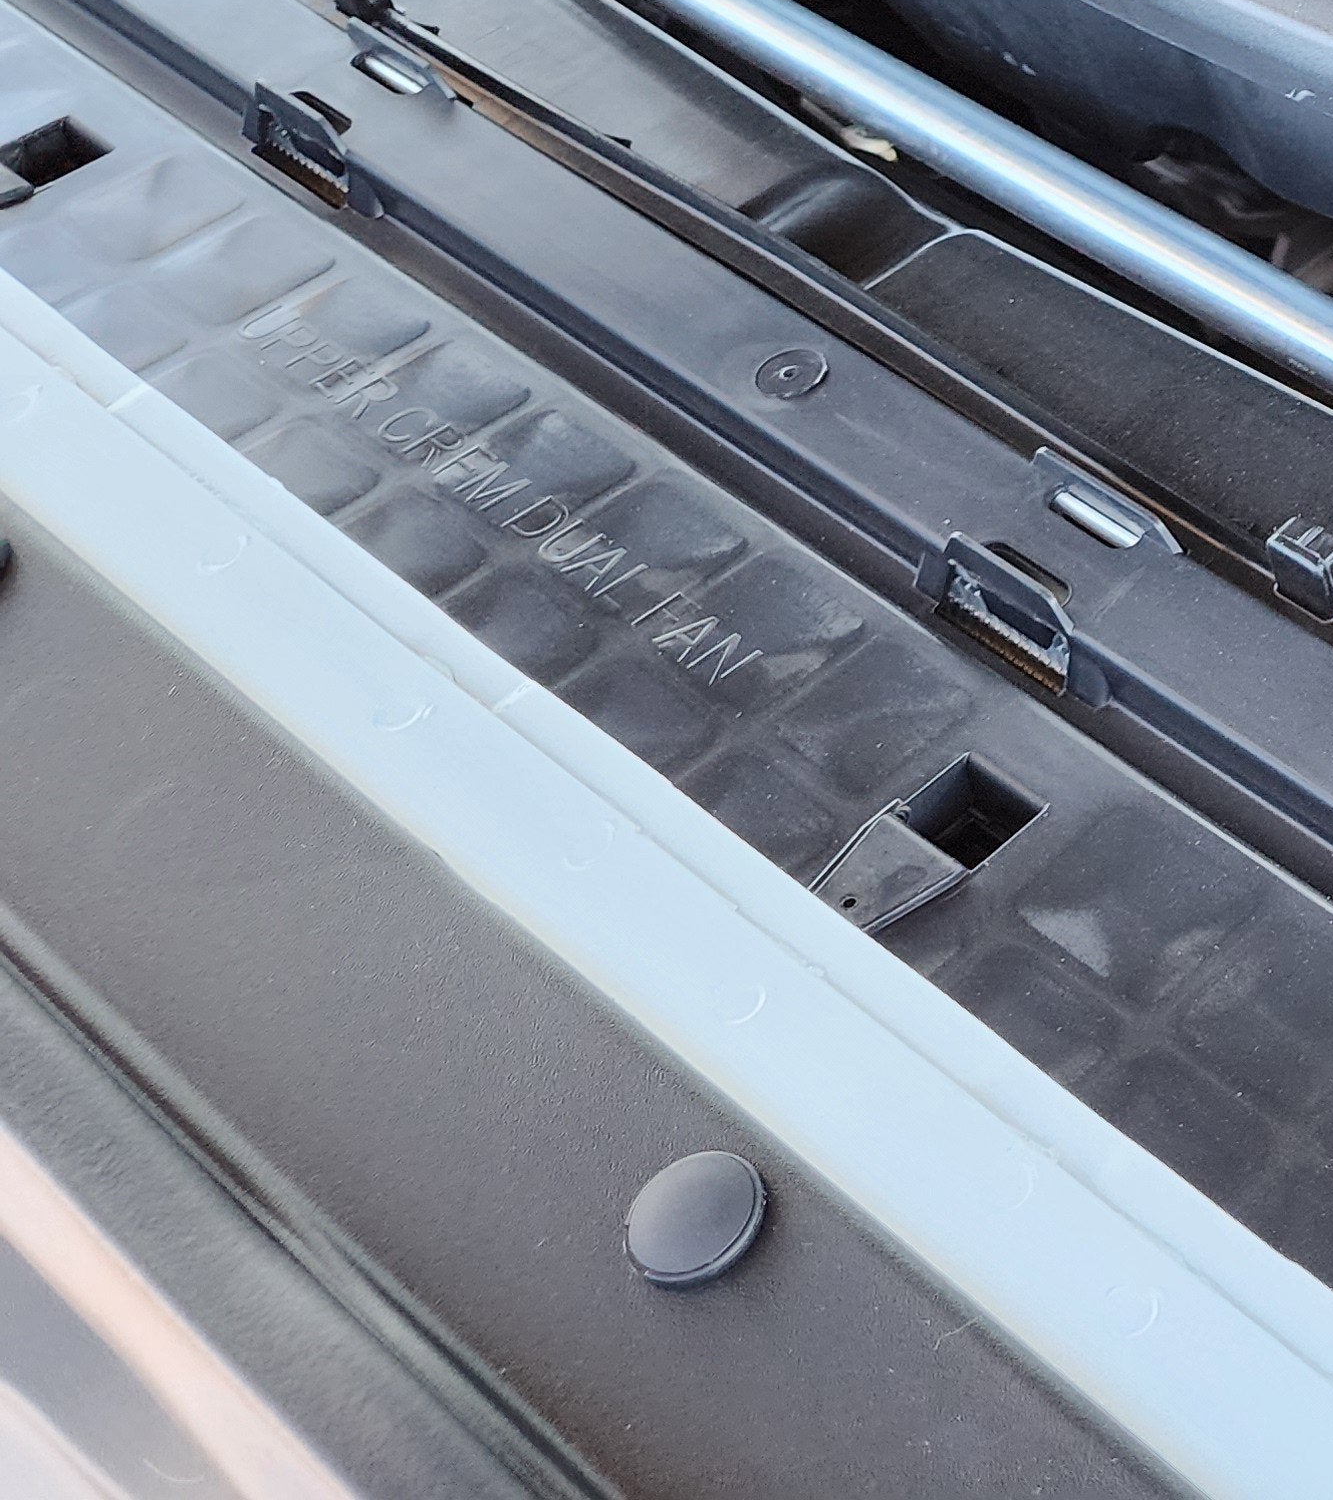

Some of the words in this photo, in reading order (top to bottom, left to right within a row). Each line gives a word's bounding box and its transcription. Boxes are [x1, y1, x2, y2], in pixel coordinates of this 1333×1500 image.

[238, 304, 400, 419] UPPER
[500, 494, 649, 610] DUAL
[631, 591, 764, 687] FAN
